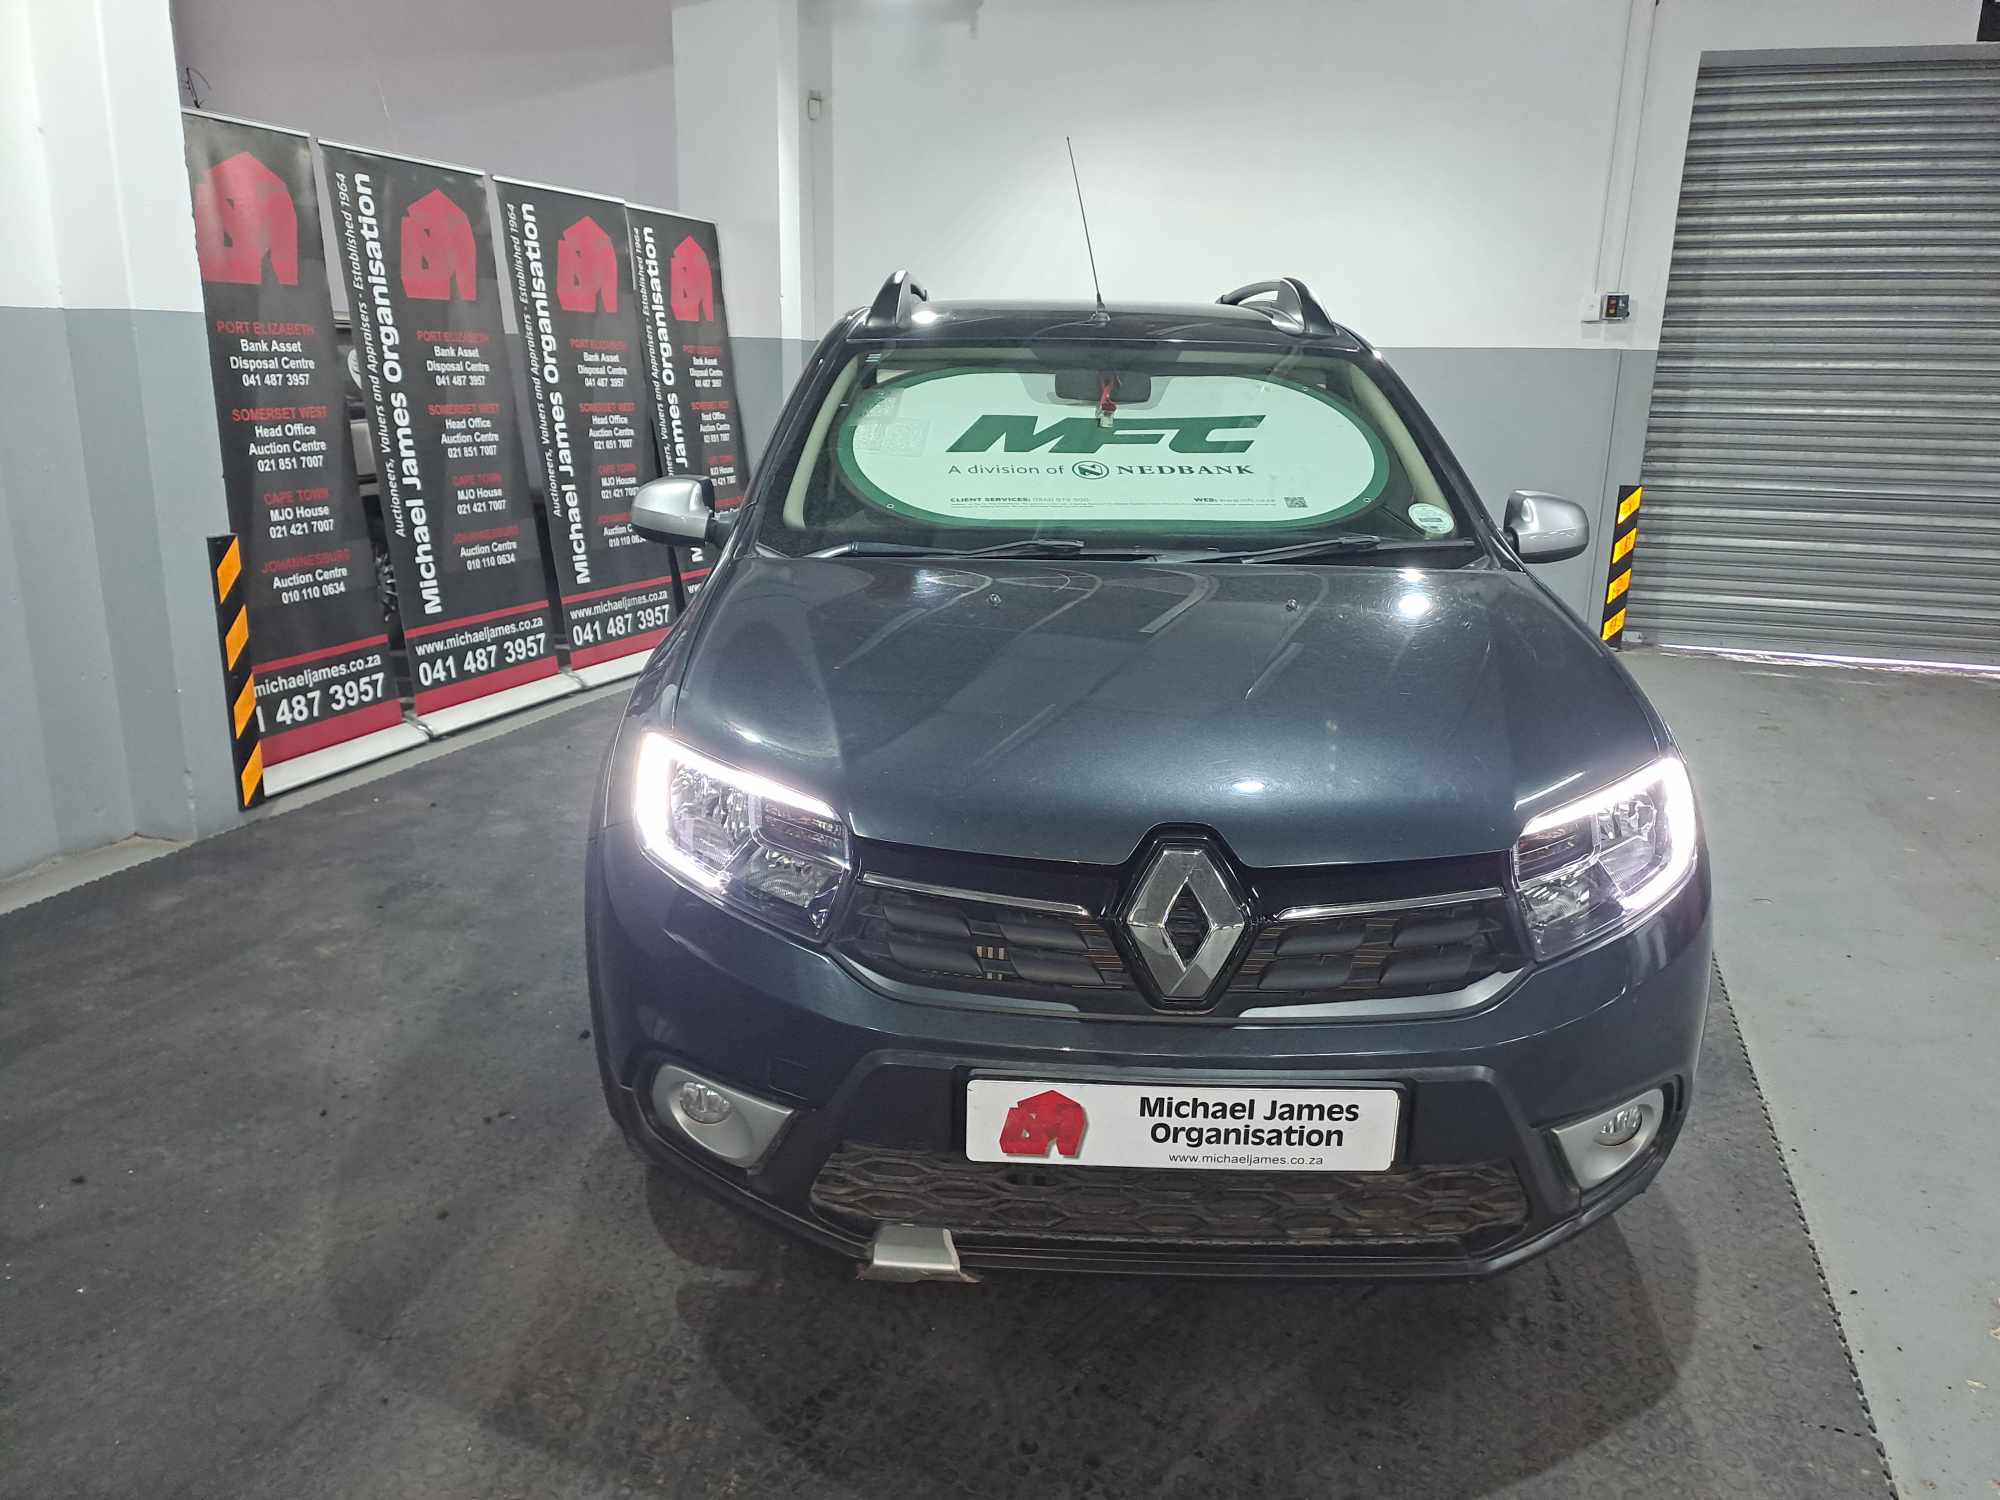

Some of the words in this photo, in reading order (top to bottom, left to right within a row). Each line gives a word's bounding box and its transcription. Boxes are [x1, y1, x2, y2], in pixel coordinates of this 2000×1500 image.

[335, 172, 350, 208] 1964
[506, 203, 520, 233] 1964
[339, 211, 365, 290] Established
[354, 172, 402, 384] Organisation
[510, 235, 529, 304] Established
[521, 203, 559, 384] Organisation
[643, 226, 675, 386] Organisation
[216, 320, 250, 334] PORT
[358, 302, 378, 372] Appraisers
[240, 339, 269, 352] Bank
[271, 340, 302, 352] Asset
[434, 346, 456, 357] Bank
[457, 347, 480, 357] Asset
[523, 314, 540, 376] Appraisers
[229, 356, 279, 371] Disposal
[281, 357, 315, 369] Centre
[427, 360, 463, 373] Disposal
[465, 361, 490, 372] Centre
[242, 374, 261, 386] 041
[264, 374, 283, 386] 487
[287, 373, 310, 386] 3957
[368, 374, 384, 402] and
[435, 375, 450, 386] 041
[530, 377, 544, 400] and
[255, 425, 283, 437] Head
[284, 423, 316, 436] Office
[376, 405, 391, 453] Valuers
[445, 418, 466, 429] Head
[468, 417, 492, 428] Office
[537, 403, 551, 445] Valuers
[550, 391, 574, 478] James
[667, 392, 688, 468] James
[945, 414, 1266, 454] MFC
[249, 442, 291, 455] Auction
[293, 440, 326, 452] Centre
[390, 392, 422, 491] James
[441, 433, 472, 445] Auction
[474, 432, 499, 443] Centre
[257, 459, 276, 472] 021
[278, 457, 297, 470] 851
[300, 455, 324, 468] 7007
[447, 447, 462, 458] 021
[544, 448, 562, 518] Auctioneers,
[948, 465, 961, 475] A
[967, 464, 1040, 475] division
[1046, 464, 1064, 475] of
[1117, 464, 1255, 476] NEDBANK
[385, 458, 406, 538] Auctioneers,
[457, 489, 475, 500] MJO
[476, 487, 503, 499] House
[457, 504, 472, 515] 021
[472, 502, 487, 513] 421
[489, 499, 507, 511] 7007
[270, 508, 294, 522] MJO
[296, 506, 330, 519] House
[269, 526, 288, 539] 021
[290, 522, 309, 536] 421
[312, 519, 334, 532] 7007
[561, 484, 591, 585] Michael
[405, 498, 443, 615] Michael
[460, 544, 490, 558] Auction
[491, 541, 518, 552] Centre
[466, 559, 481, 571] 010
[482, 556, 496, 568] 110
[273, 572, 313, 589] Auction
[315, 567, 347, 581] Centre
[282, 590, 300, 604] 010
[302, 586, 320, 600] 110
[322, 581, 346, 596] 0634
[570, 590, 668, 620] www.michaeljames.co.za
[415, 616, 543, 656] www.michaeljames.co.za
[572, 621, 601, 646] 041
[606, 612, 633, 637] 487
[637, 604, 670, 630] 3957
[419, 655, 457, 686] 041
[463, 644, 497, 673] 487
[503, 632, 546, 663] 3957
[254, 654, 381, 698] michaeljames.co.za
[276, 690, 320, 725] 487
[329, 672, 384, 711] 3957
[1139, 1096, 1256, 1121] Michael
[1263, 1100, 1360, 1122] James
[1150, 1122, 1344, 1148] Organisation
[1168, 1153, 1324, 1166] www.michaeljames.co.za
